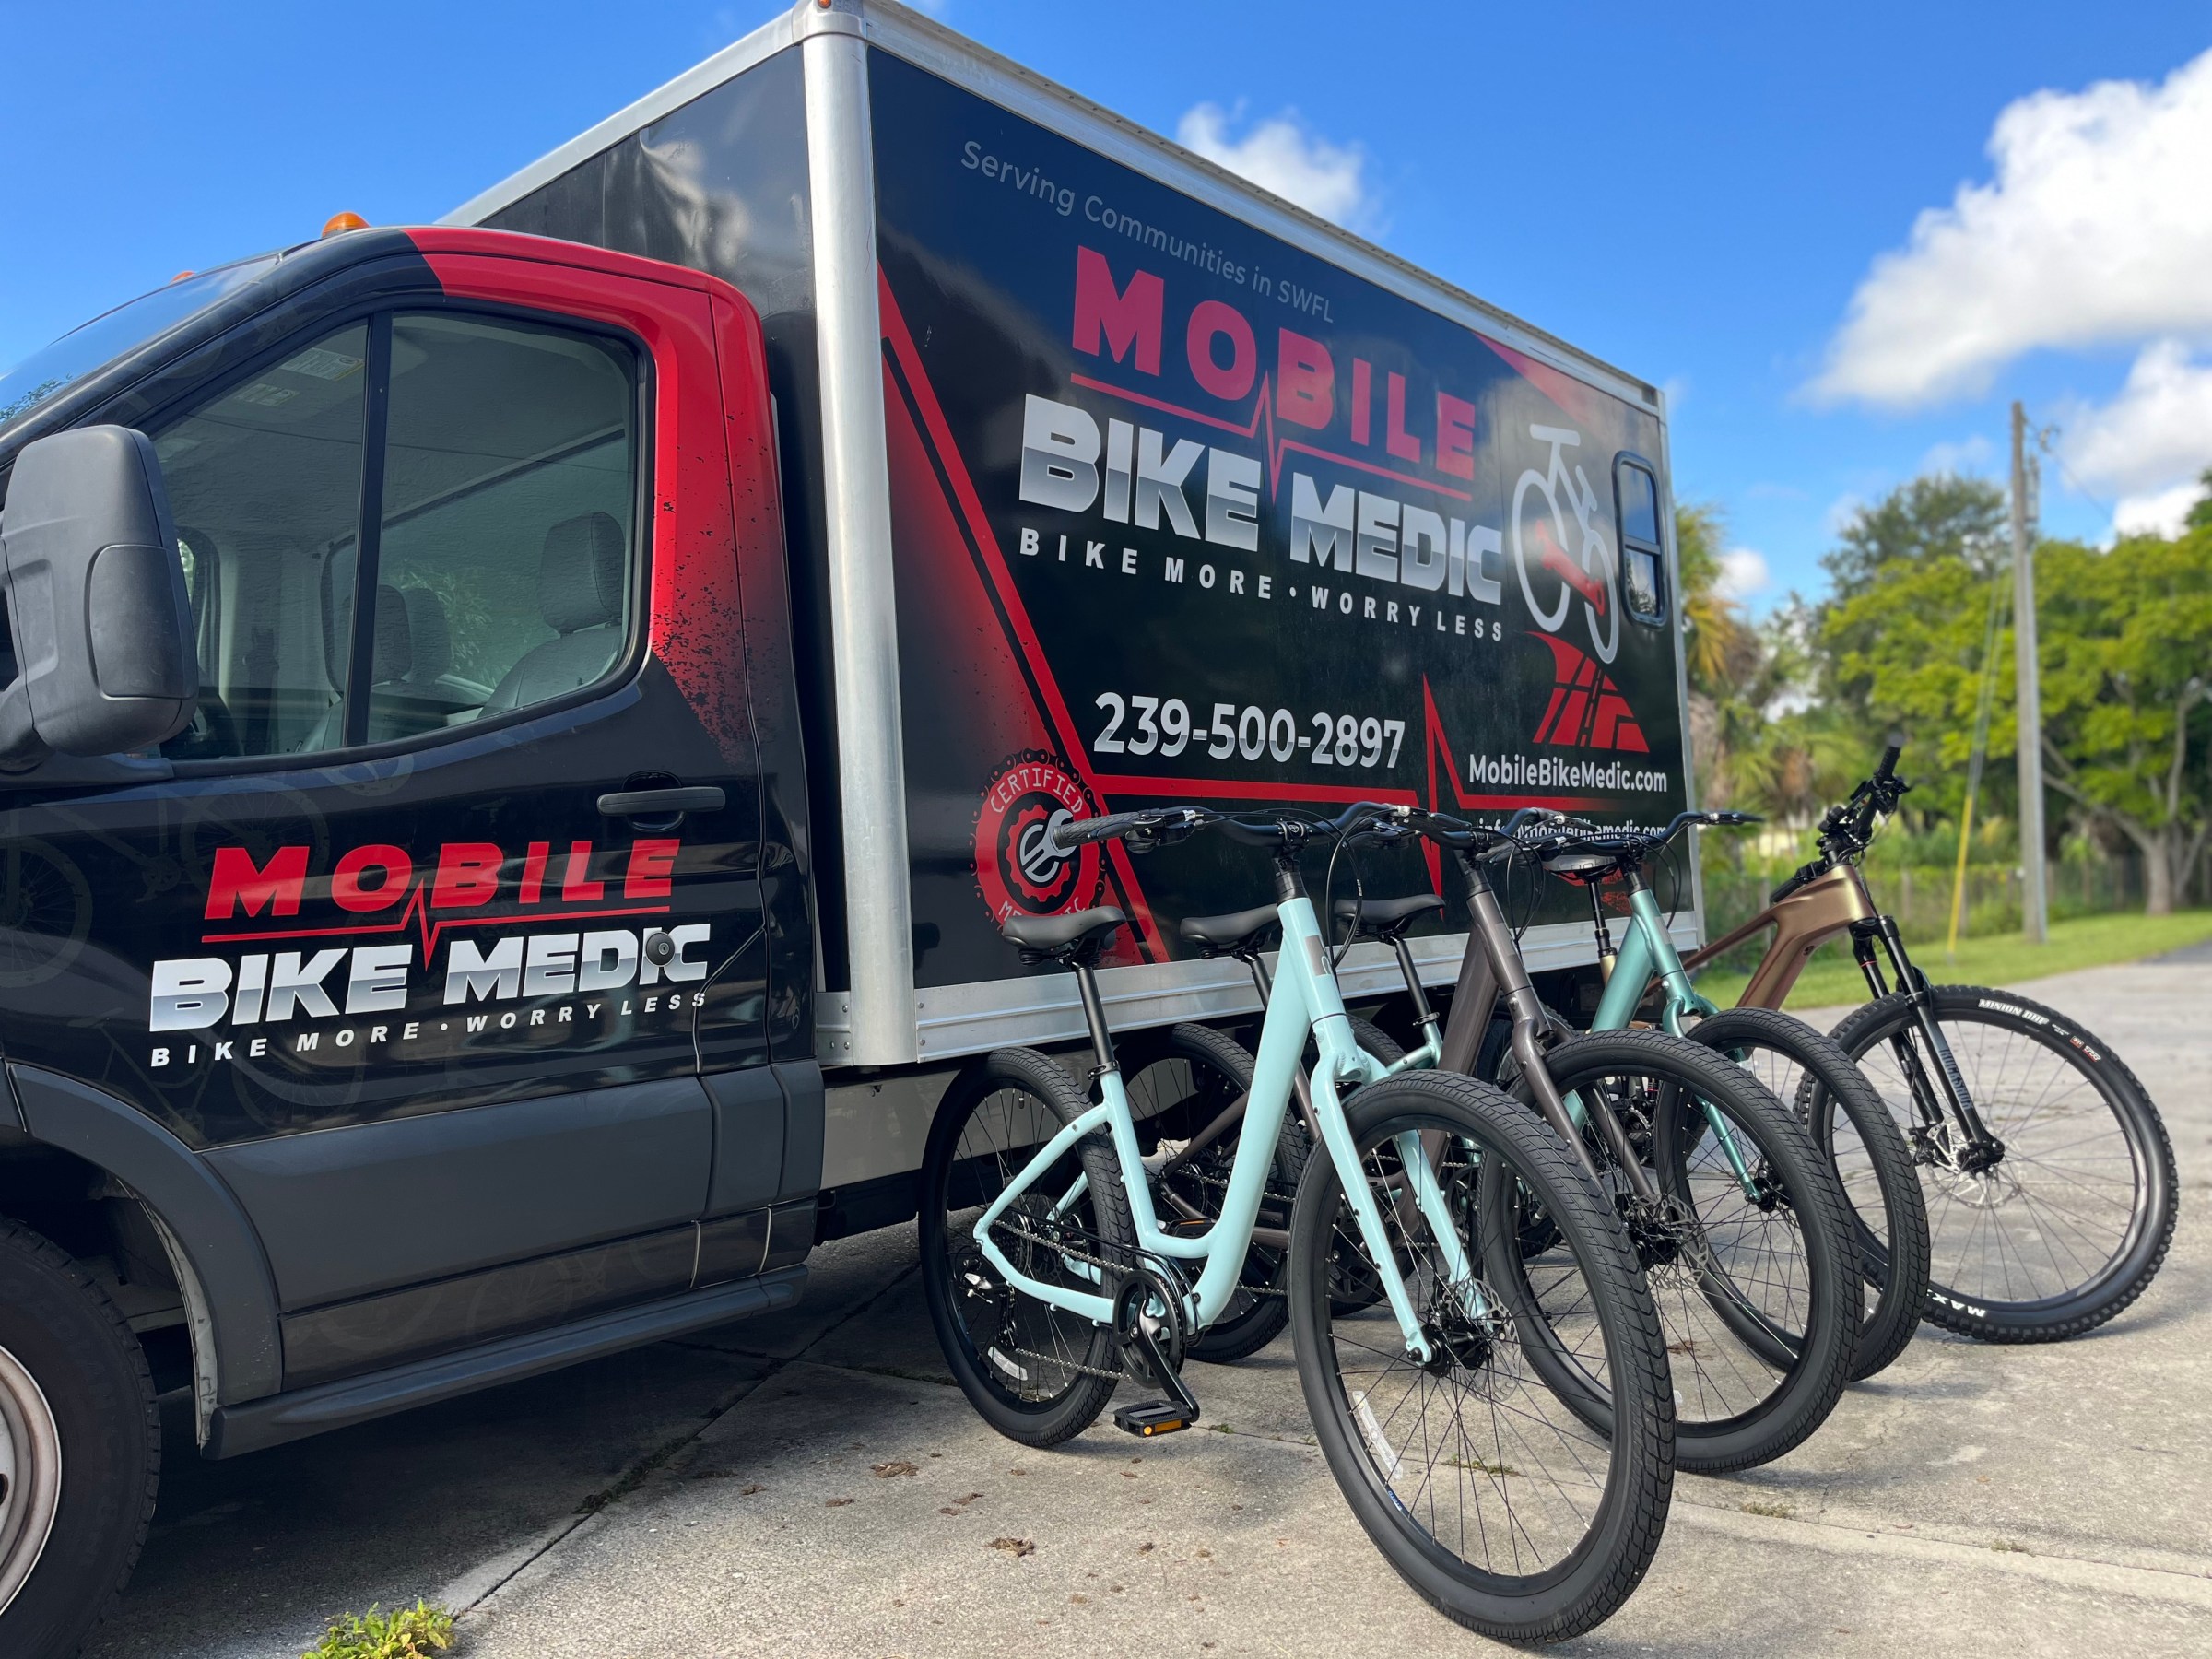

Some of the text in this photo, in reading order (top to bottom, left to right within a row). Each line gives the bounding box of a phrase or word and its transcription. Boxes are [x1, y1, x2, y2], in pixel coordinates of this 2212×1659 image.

[960, 140, 1335, 324] Serving Communities in SWFL
[1071, 244, 1477, 482] MOBILE
[1018, 393, 1502, 606] BIKE MEDIC
[1019, 527, 1502, 642] BIKE MORE WORRY LESS
[1092, 691, 1406, 770] 239-500-2897
[990, 767, 1084, 813] CERTIFIED
[1468, 753, 1668, 793] MobileBikeMedic.com
[204, 839, 681, 920] MOBILE
[149, 924, 711, 1032] BIKE MEDIC
[1978, 998, 2022, 1017] MINION
[150, 992, 706, 1067] BIKE MORE WORRY LESS
[1926, 1288, 1986, 1318] MAX
